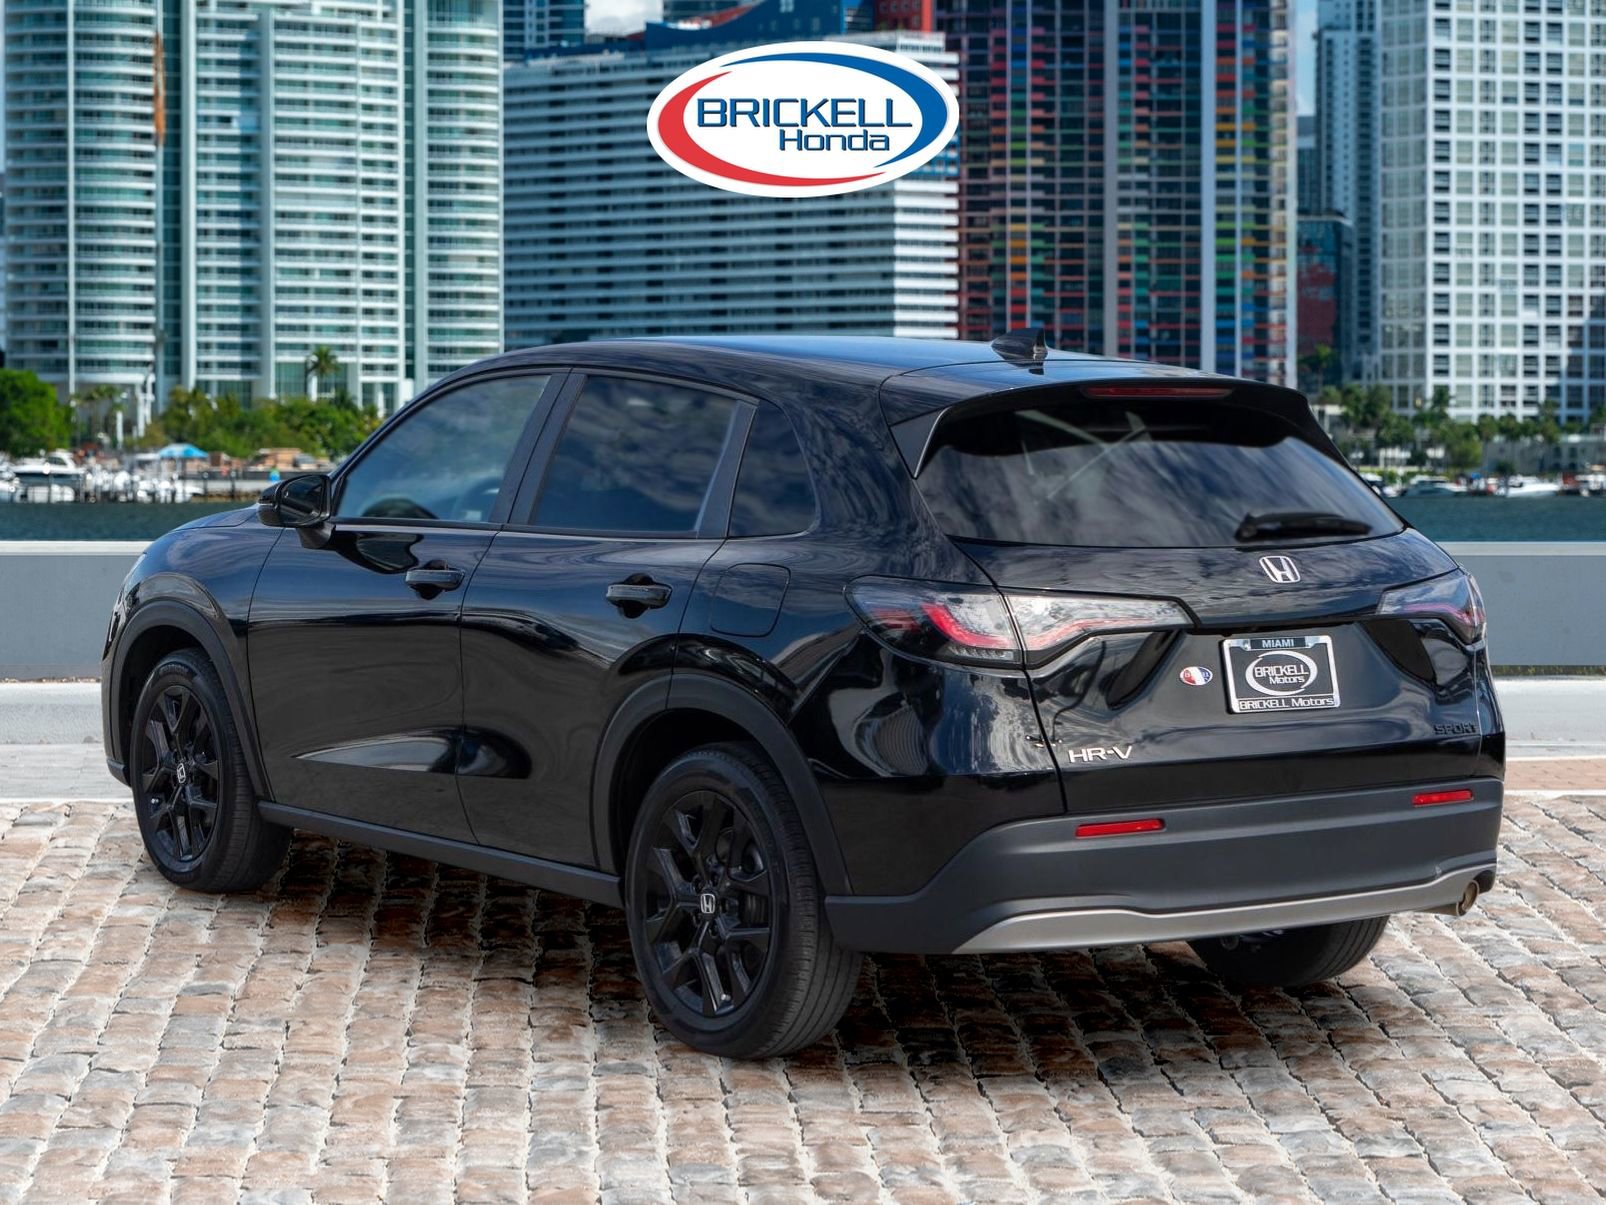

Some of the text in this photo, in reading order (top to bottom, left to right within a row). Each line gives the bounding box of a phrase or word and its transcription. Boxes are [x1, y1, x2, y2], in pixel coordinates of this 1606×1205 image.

[1261, 638, 1295, 648] MIAMI
[1254, 664, 1309, 678] BRICKELL
[1269, 675, 1305, 685] Motors
[1239, 696, 1334, 710] BRICKELL Motors
[1433, 722, 1476, 735] SPORT
[1068, 745, 1132, 763] HR-V
